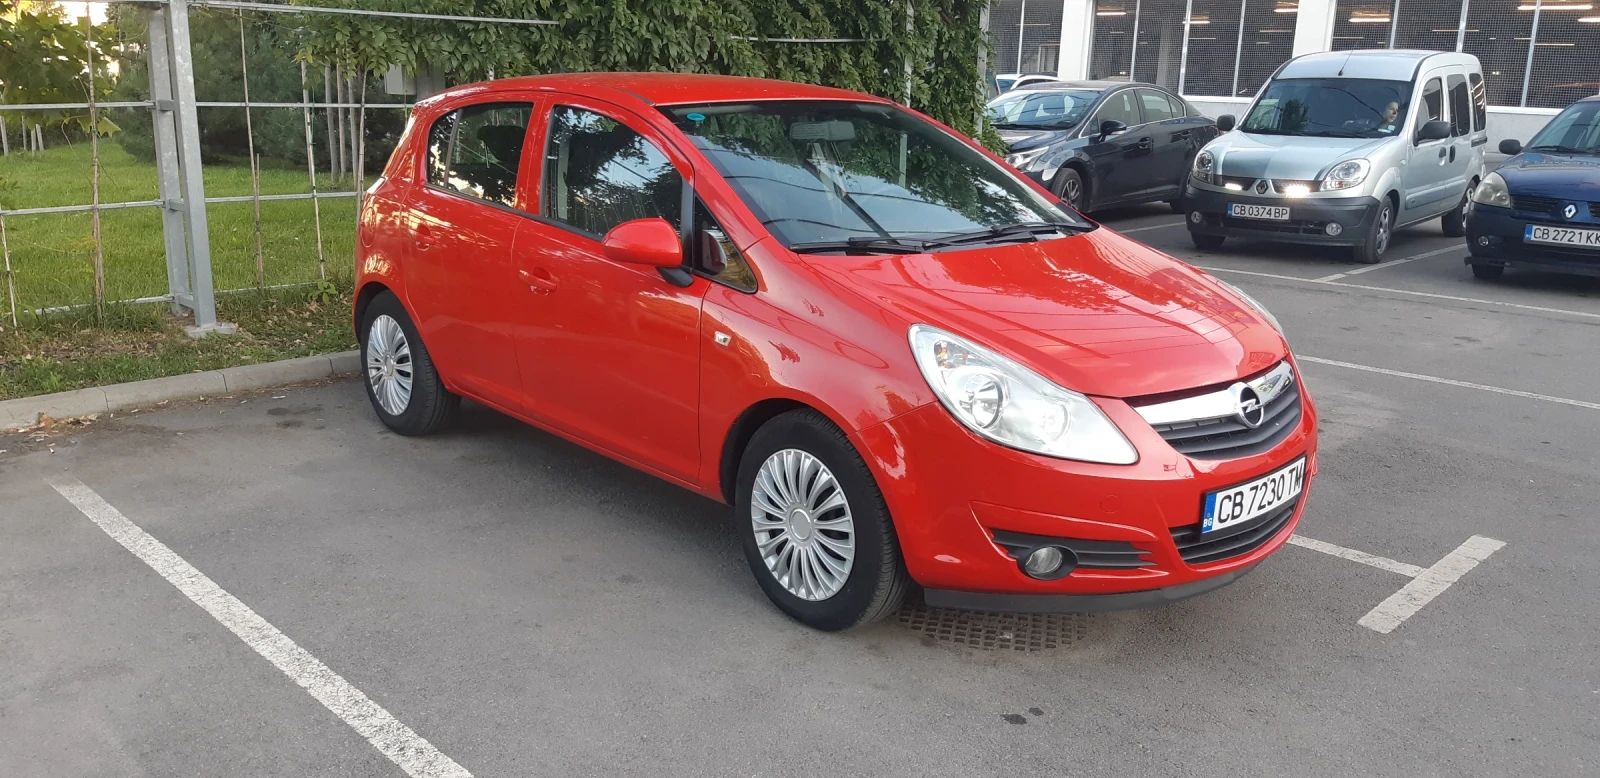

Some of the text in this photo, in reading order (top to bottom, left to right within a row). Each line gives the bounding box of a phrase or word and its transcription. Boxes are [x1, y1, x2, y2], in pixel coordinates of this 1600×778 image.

[1234, 205, 1246, 215] CB
[1248, 206, 1272, 217] 0374
[1274, 208, 1288, 218] BP
[1533, 228, 1550, 239] CB
[1552, 229, 1582, 243] 2721
[1217, 461, 1304, 524] CB 7230 TM
[1203, 517, 1213, 528] BG
